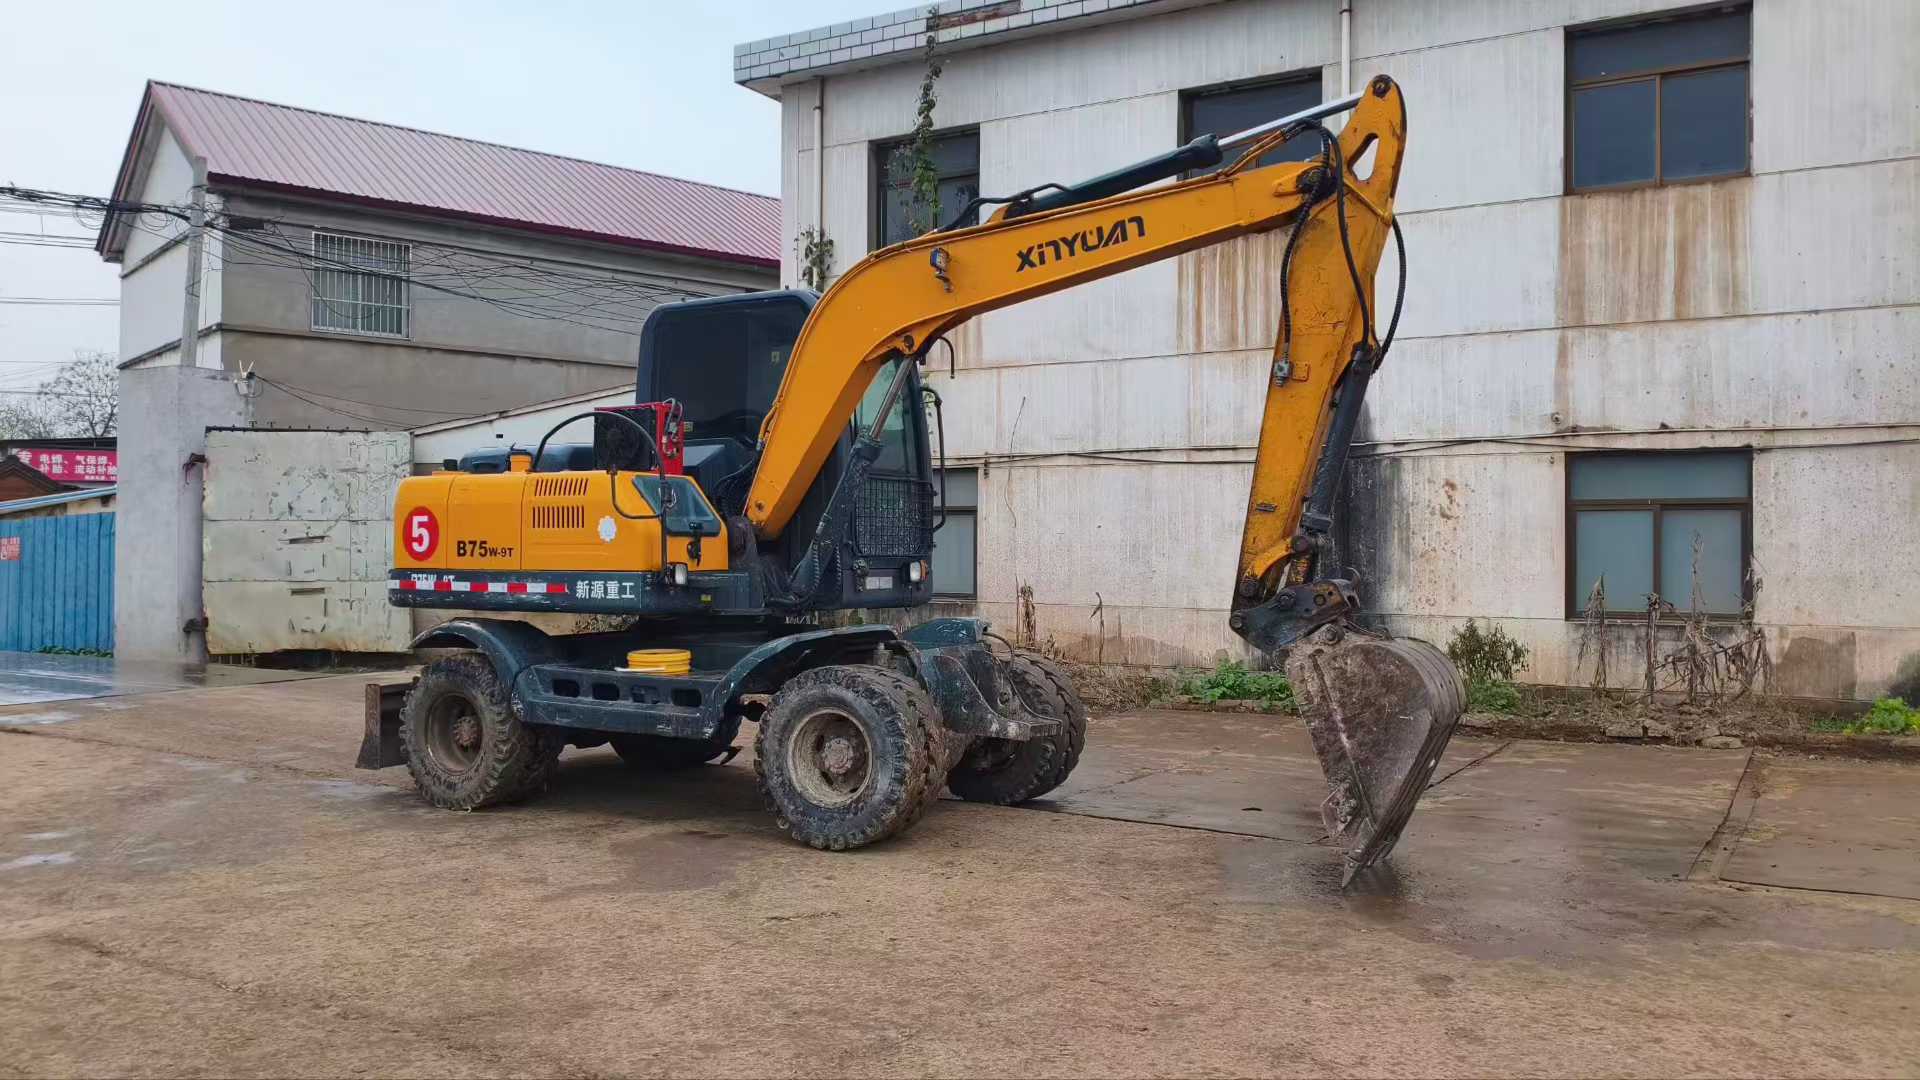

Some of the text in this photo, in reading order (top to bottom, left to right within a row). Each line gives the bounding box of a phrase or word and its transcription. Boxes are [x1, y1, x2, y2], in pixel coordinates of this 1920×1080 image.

[411, 515, 430, 553] 5
[456, 540, 514, 558] B75W-9T
[576, 580, 635, 599] 新源重工
